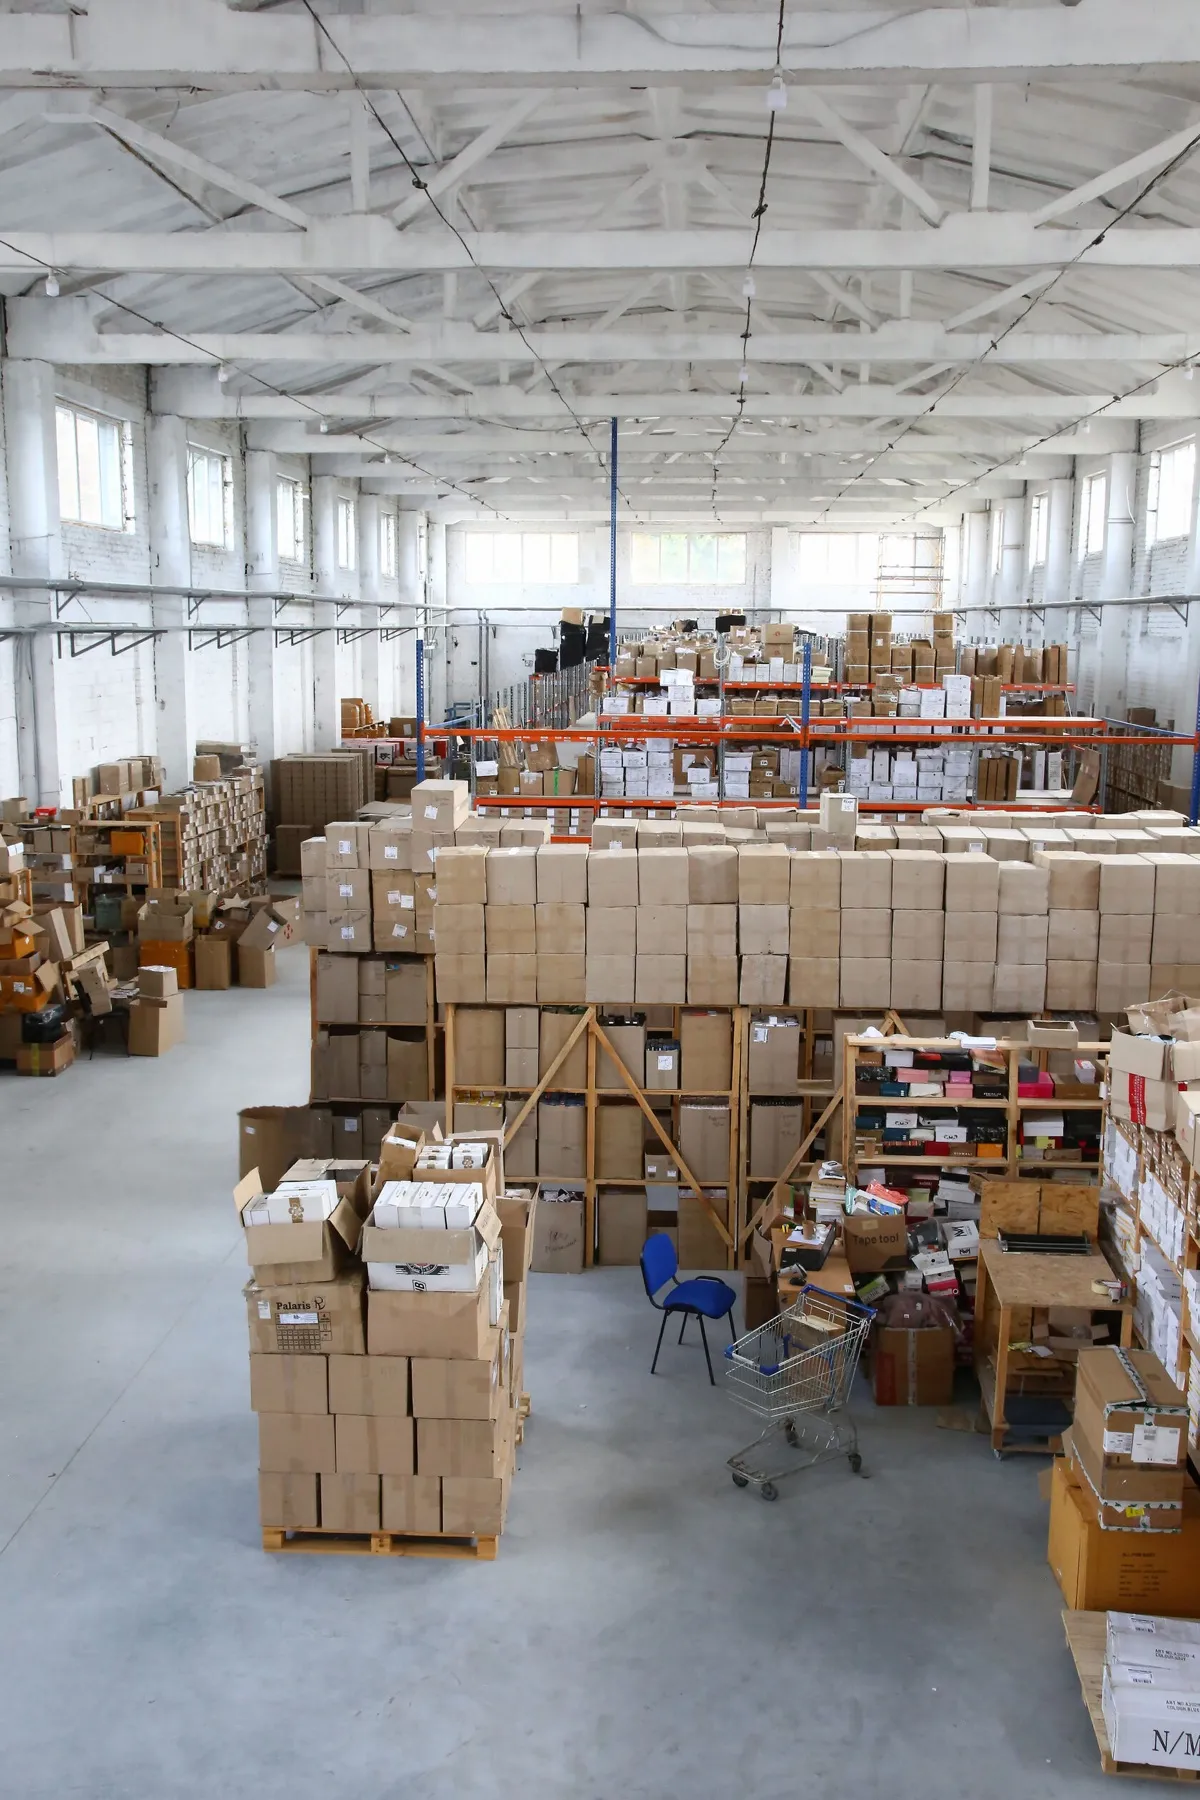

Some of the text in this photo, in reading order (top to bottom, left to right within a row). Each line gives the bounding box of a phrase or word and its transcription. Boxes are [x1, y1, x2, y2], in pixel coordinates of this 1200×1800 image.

[853, 1232, 899, 1246] Tape tool
[276, 1301, 311, 1310] Palaris
